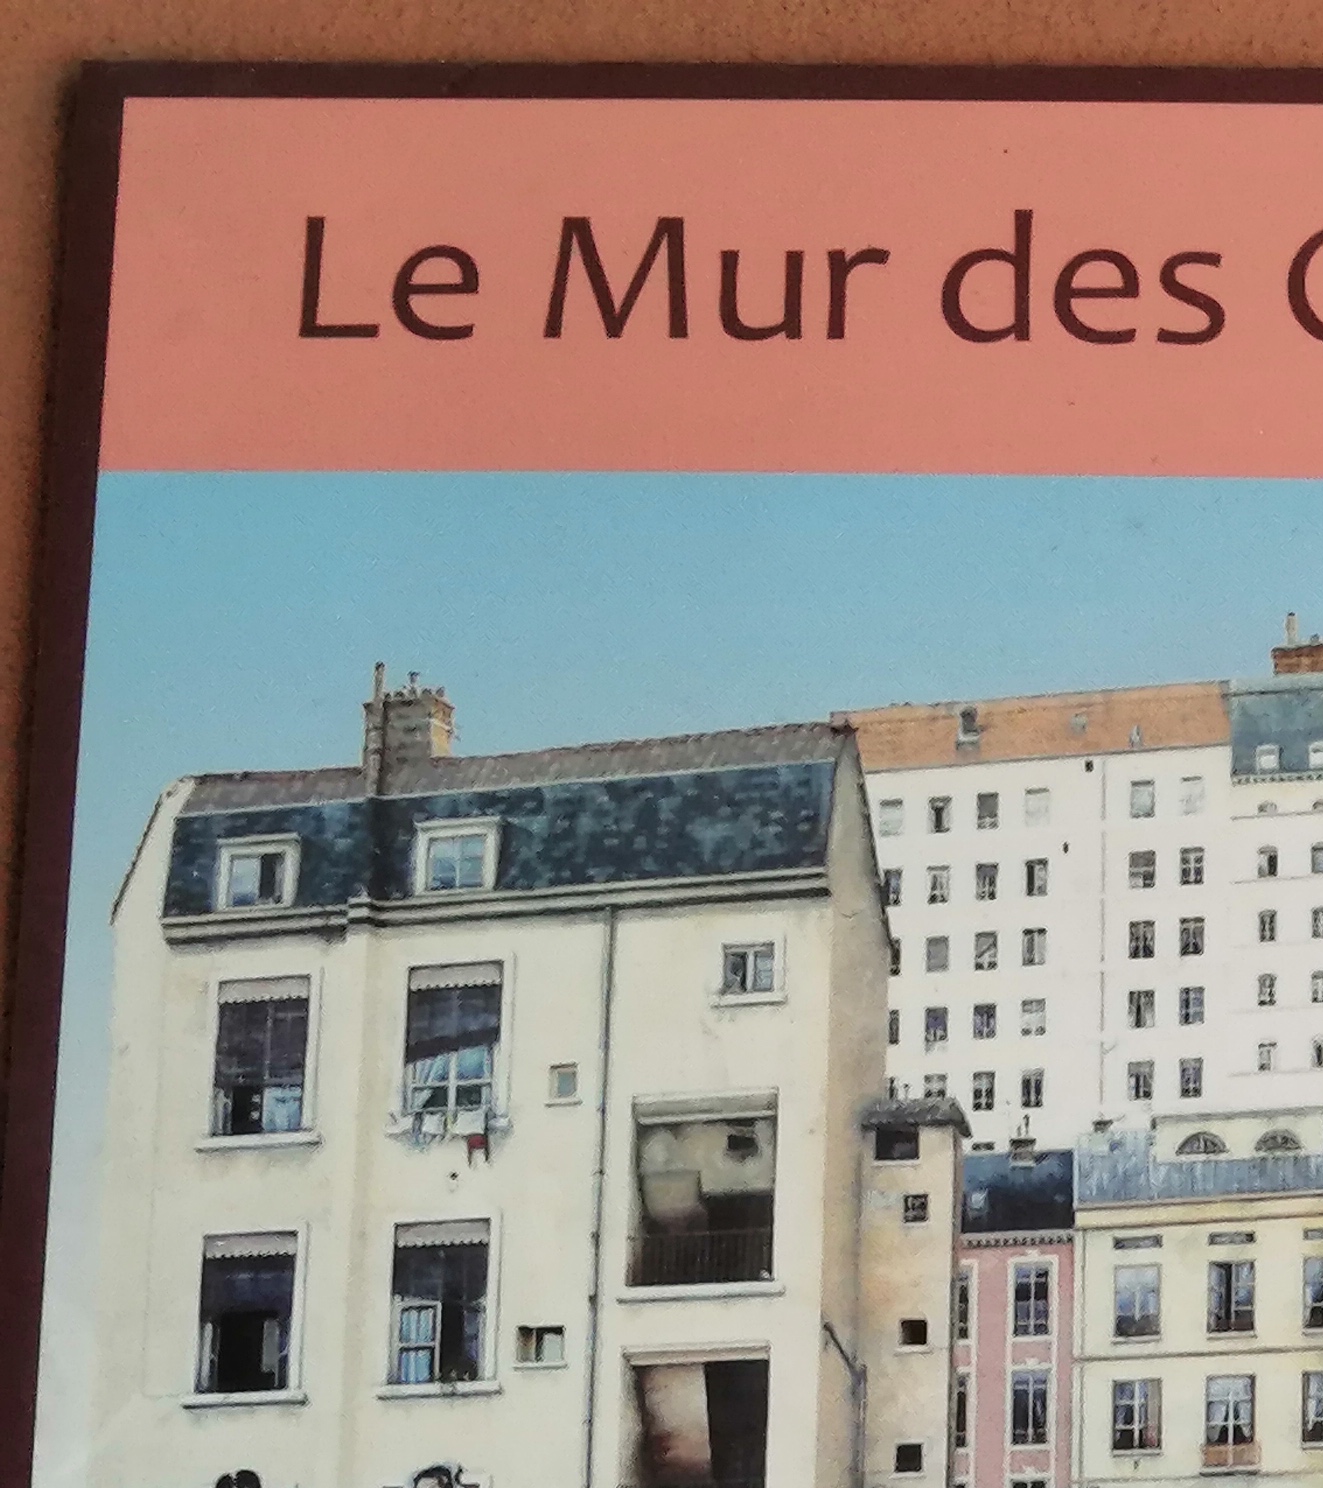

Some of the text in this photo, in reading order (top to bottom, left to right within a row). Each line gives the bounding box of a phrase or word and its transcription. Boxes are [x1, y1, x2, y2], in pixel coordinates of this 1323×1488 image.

[299, 216, 479, 341] Le
[543, 216, 891, 341] Mur
[941, 209, 1225, 345] des
